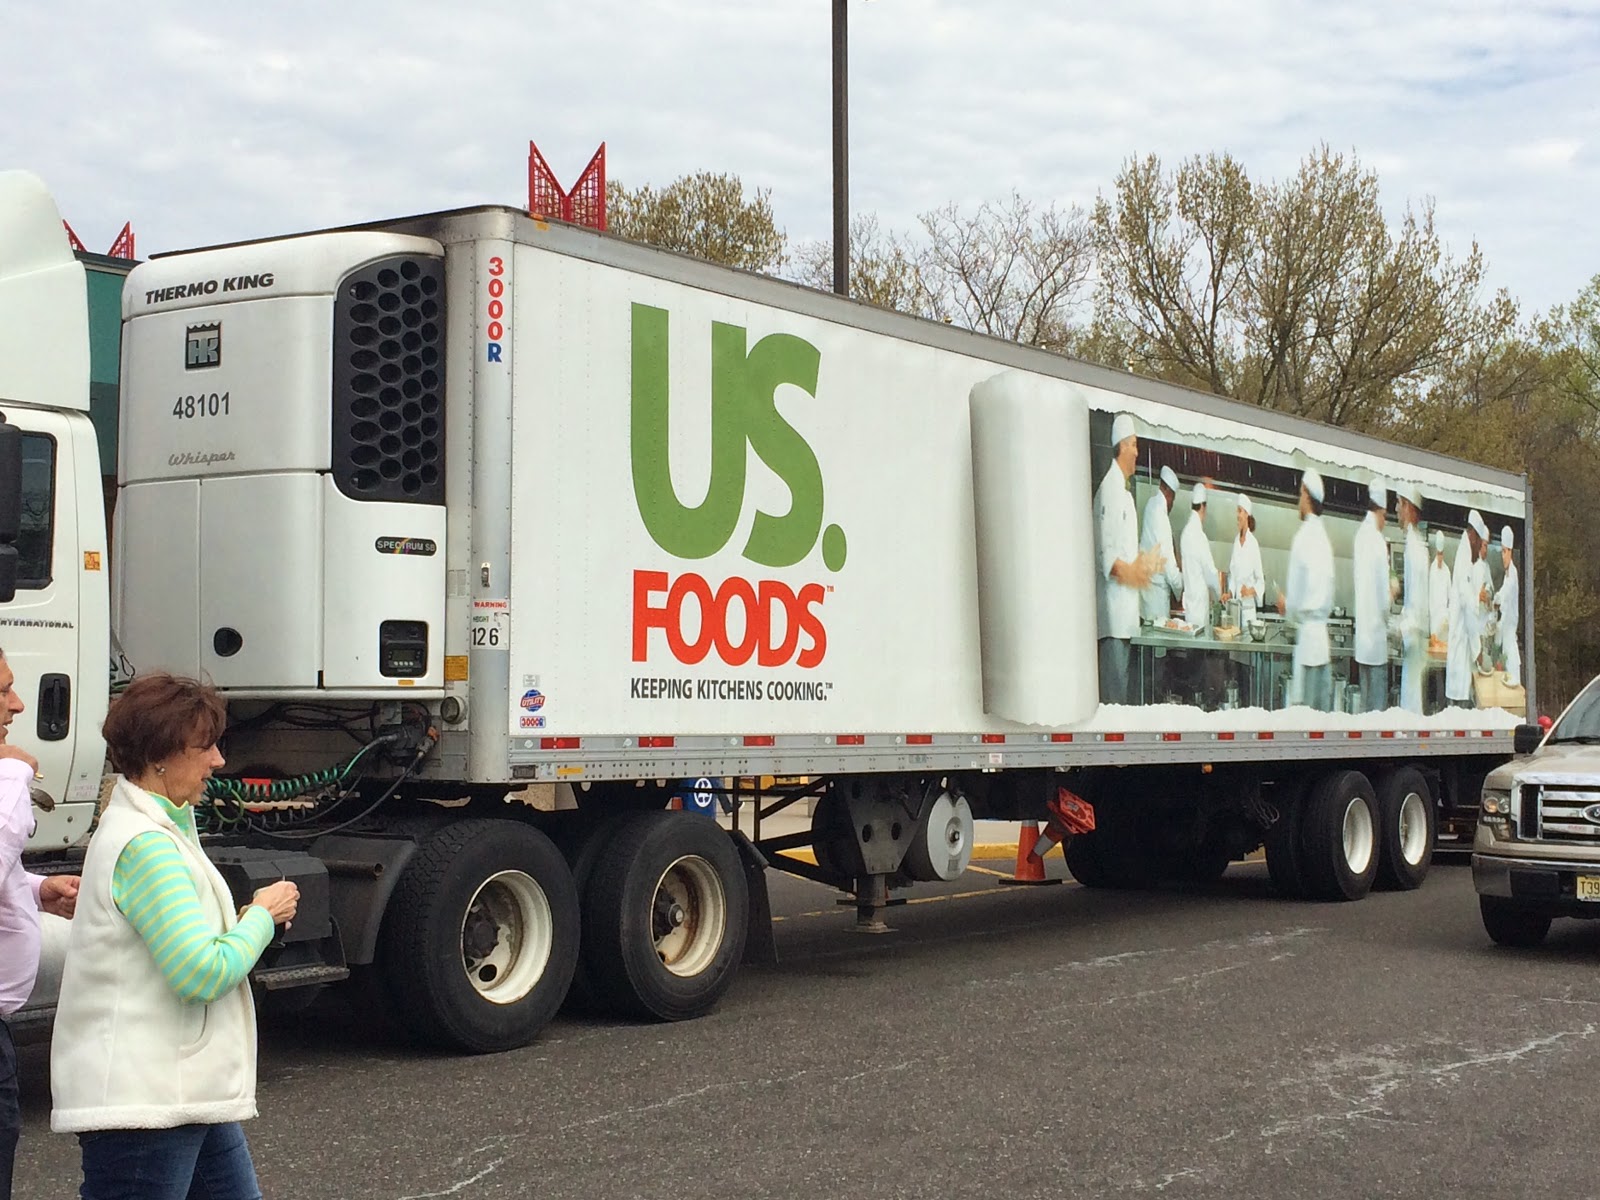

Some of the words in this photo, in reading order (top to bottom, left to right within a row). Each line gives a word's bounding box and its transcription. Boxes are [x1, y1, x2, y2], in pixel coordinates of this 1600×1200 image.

[146, 280, 218, 304] THERMO
[223, 273, 274, 292] KING
[173, 392, 229, 420] 48101
[168, 451, 236, 466] Whisper
[377, 541, 424, 551] SPECTRUM
[474, 601, 508, 609] WARNING
[0, 619, 74, 629] NTERNATIONAL
[632, 569, 827, 668] FOODS
[631, 678, 692, 699] KEEPING
[697, 679, 763, 700] KITCHENS
[521, 696, 545, 707] UTILITY
